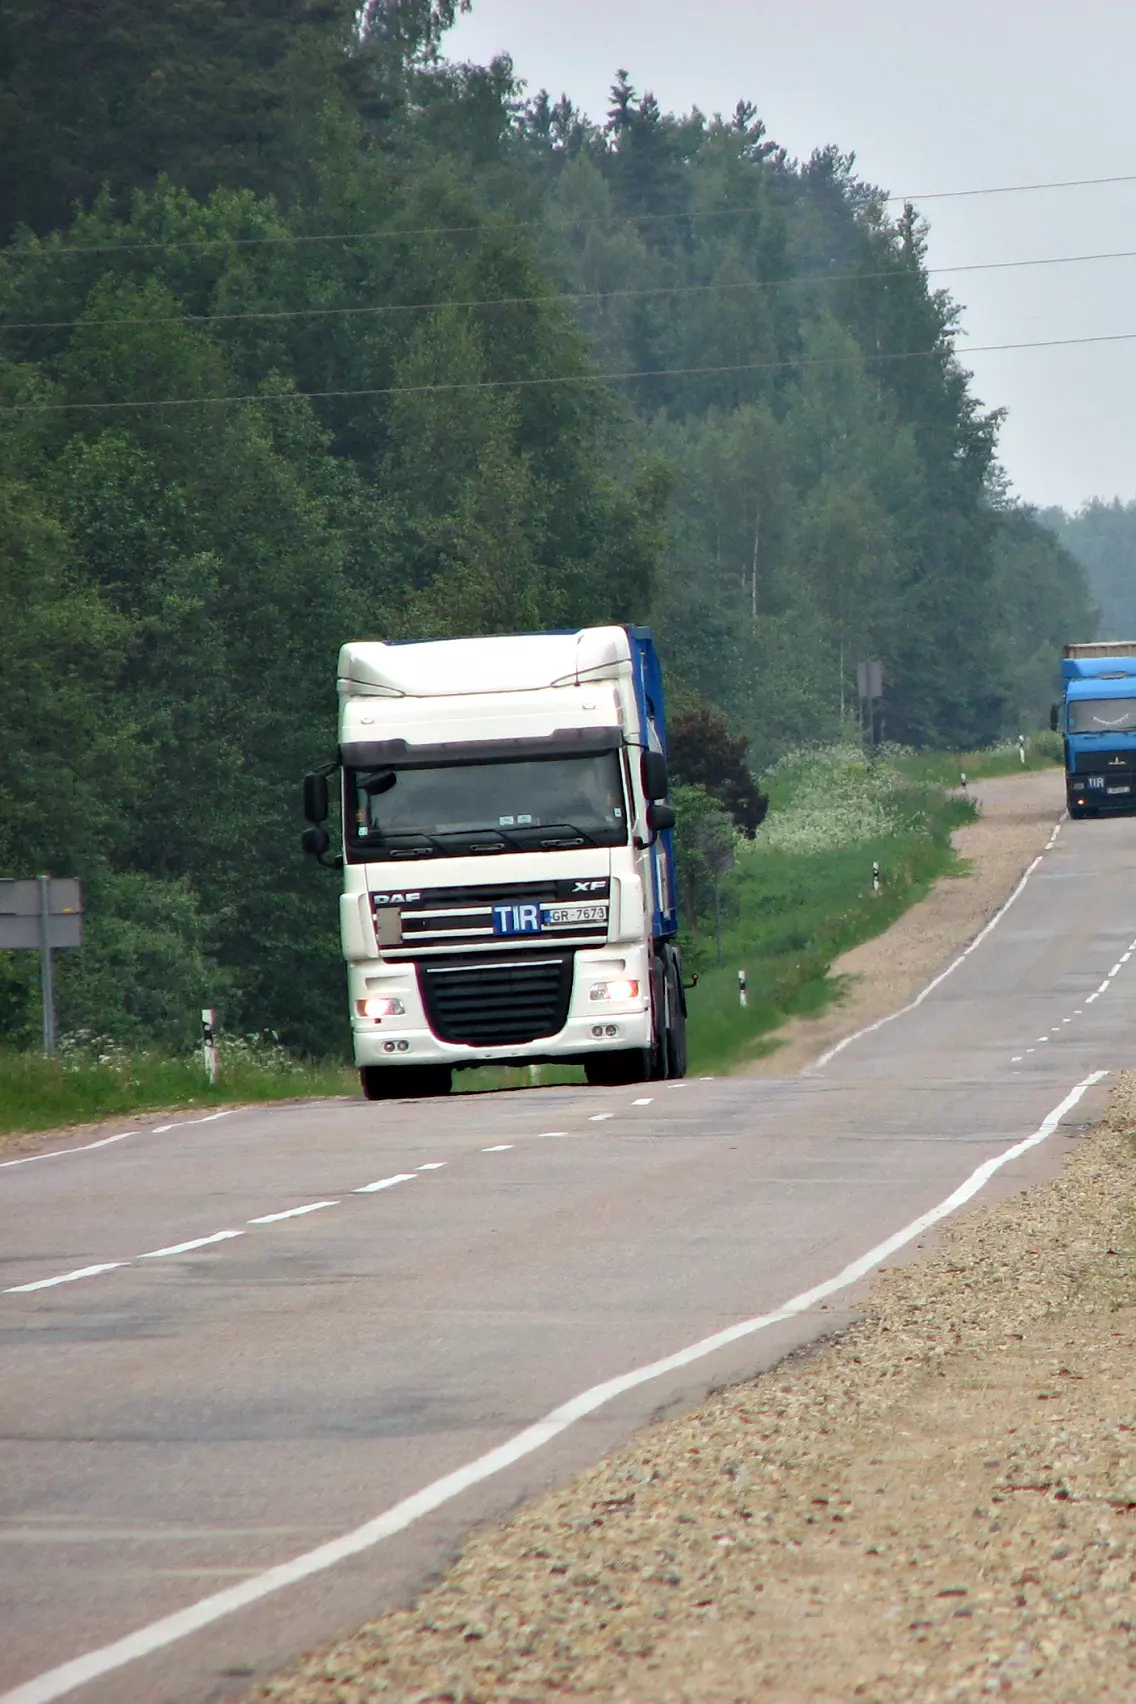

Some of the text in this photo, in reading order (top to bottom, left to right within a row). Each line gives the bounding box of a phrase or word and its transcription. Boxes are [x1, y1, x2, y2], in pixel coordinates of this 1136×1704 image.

[1088, 777, 1105, 789] TIR
[572, 880, 606, 893] XF
[373, 892, 421, 904] DAF
[493, 904, 540, 933] TIR
